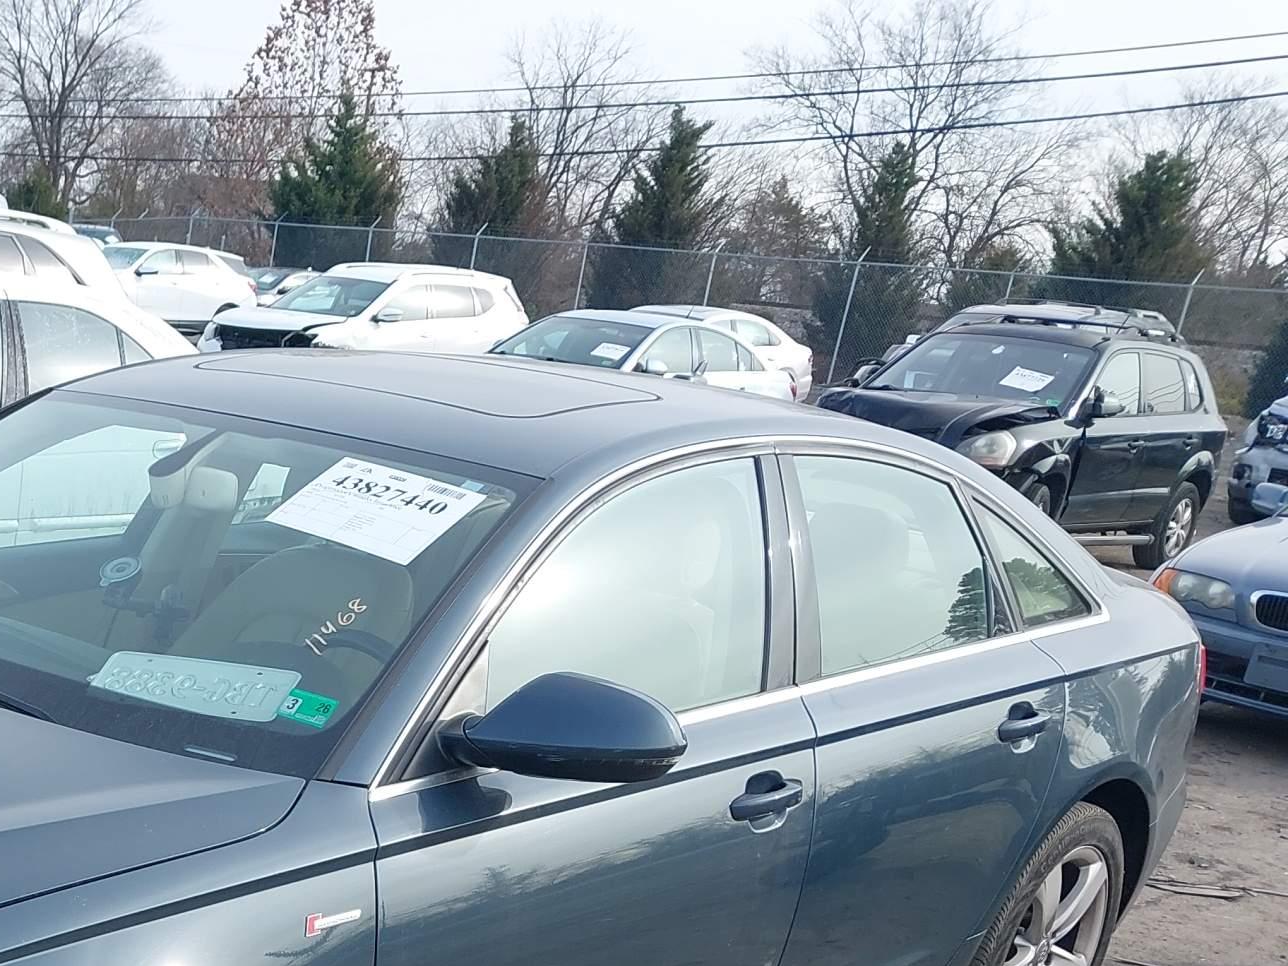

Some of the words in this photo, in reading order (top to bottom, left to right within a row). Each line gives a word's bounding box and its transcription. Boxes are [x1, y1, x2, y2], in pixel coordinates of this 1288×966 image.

[332, 475, 448, 515] 43827440
[304, 598, 367, 656] 11468
[286, 698, 299, 710] 3
[314, 702, 332, 714] 26
